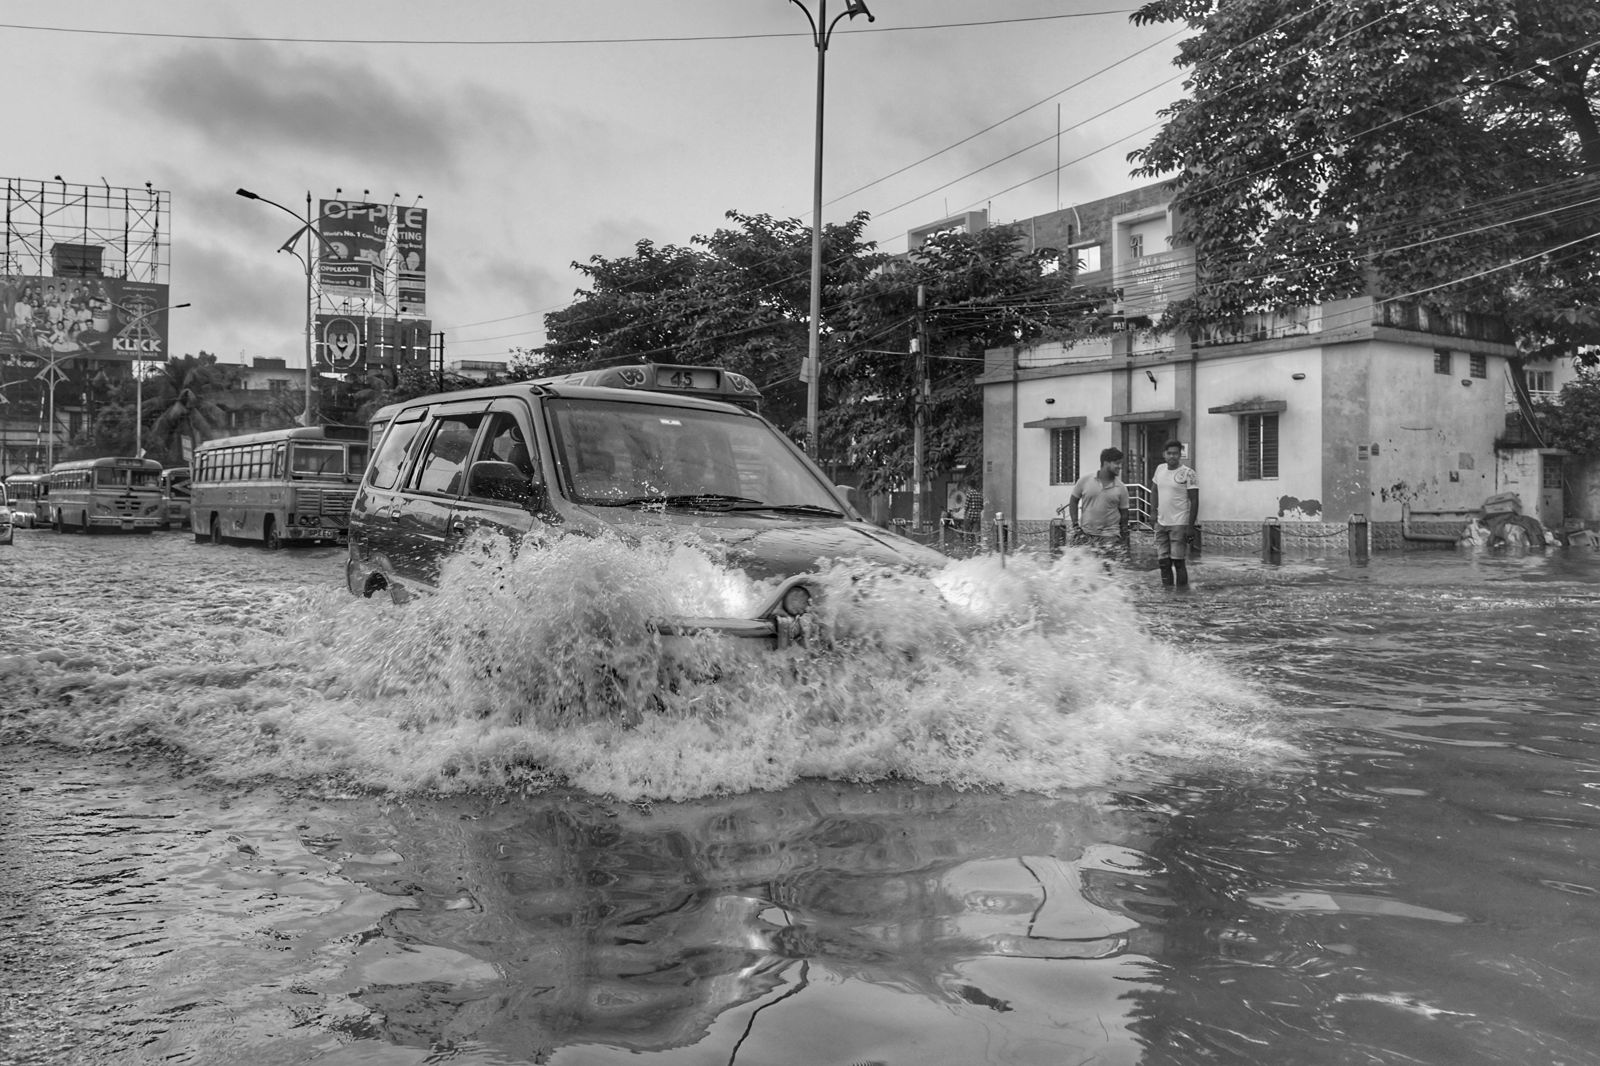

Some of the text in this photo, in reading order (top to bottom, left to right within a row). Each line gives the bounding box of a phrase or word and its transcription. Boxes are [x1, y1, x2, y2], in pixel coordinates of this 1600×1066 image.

[323, 201, 423, 229] OPPLE
[374, 224, 422, 241] LIGTING
[320, 265, 359, 273] OPPLE.COM
[670, 371, 693, 387] 45
